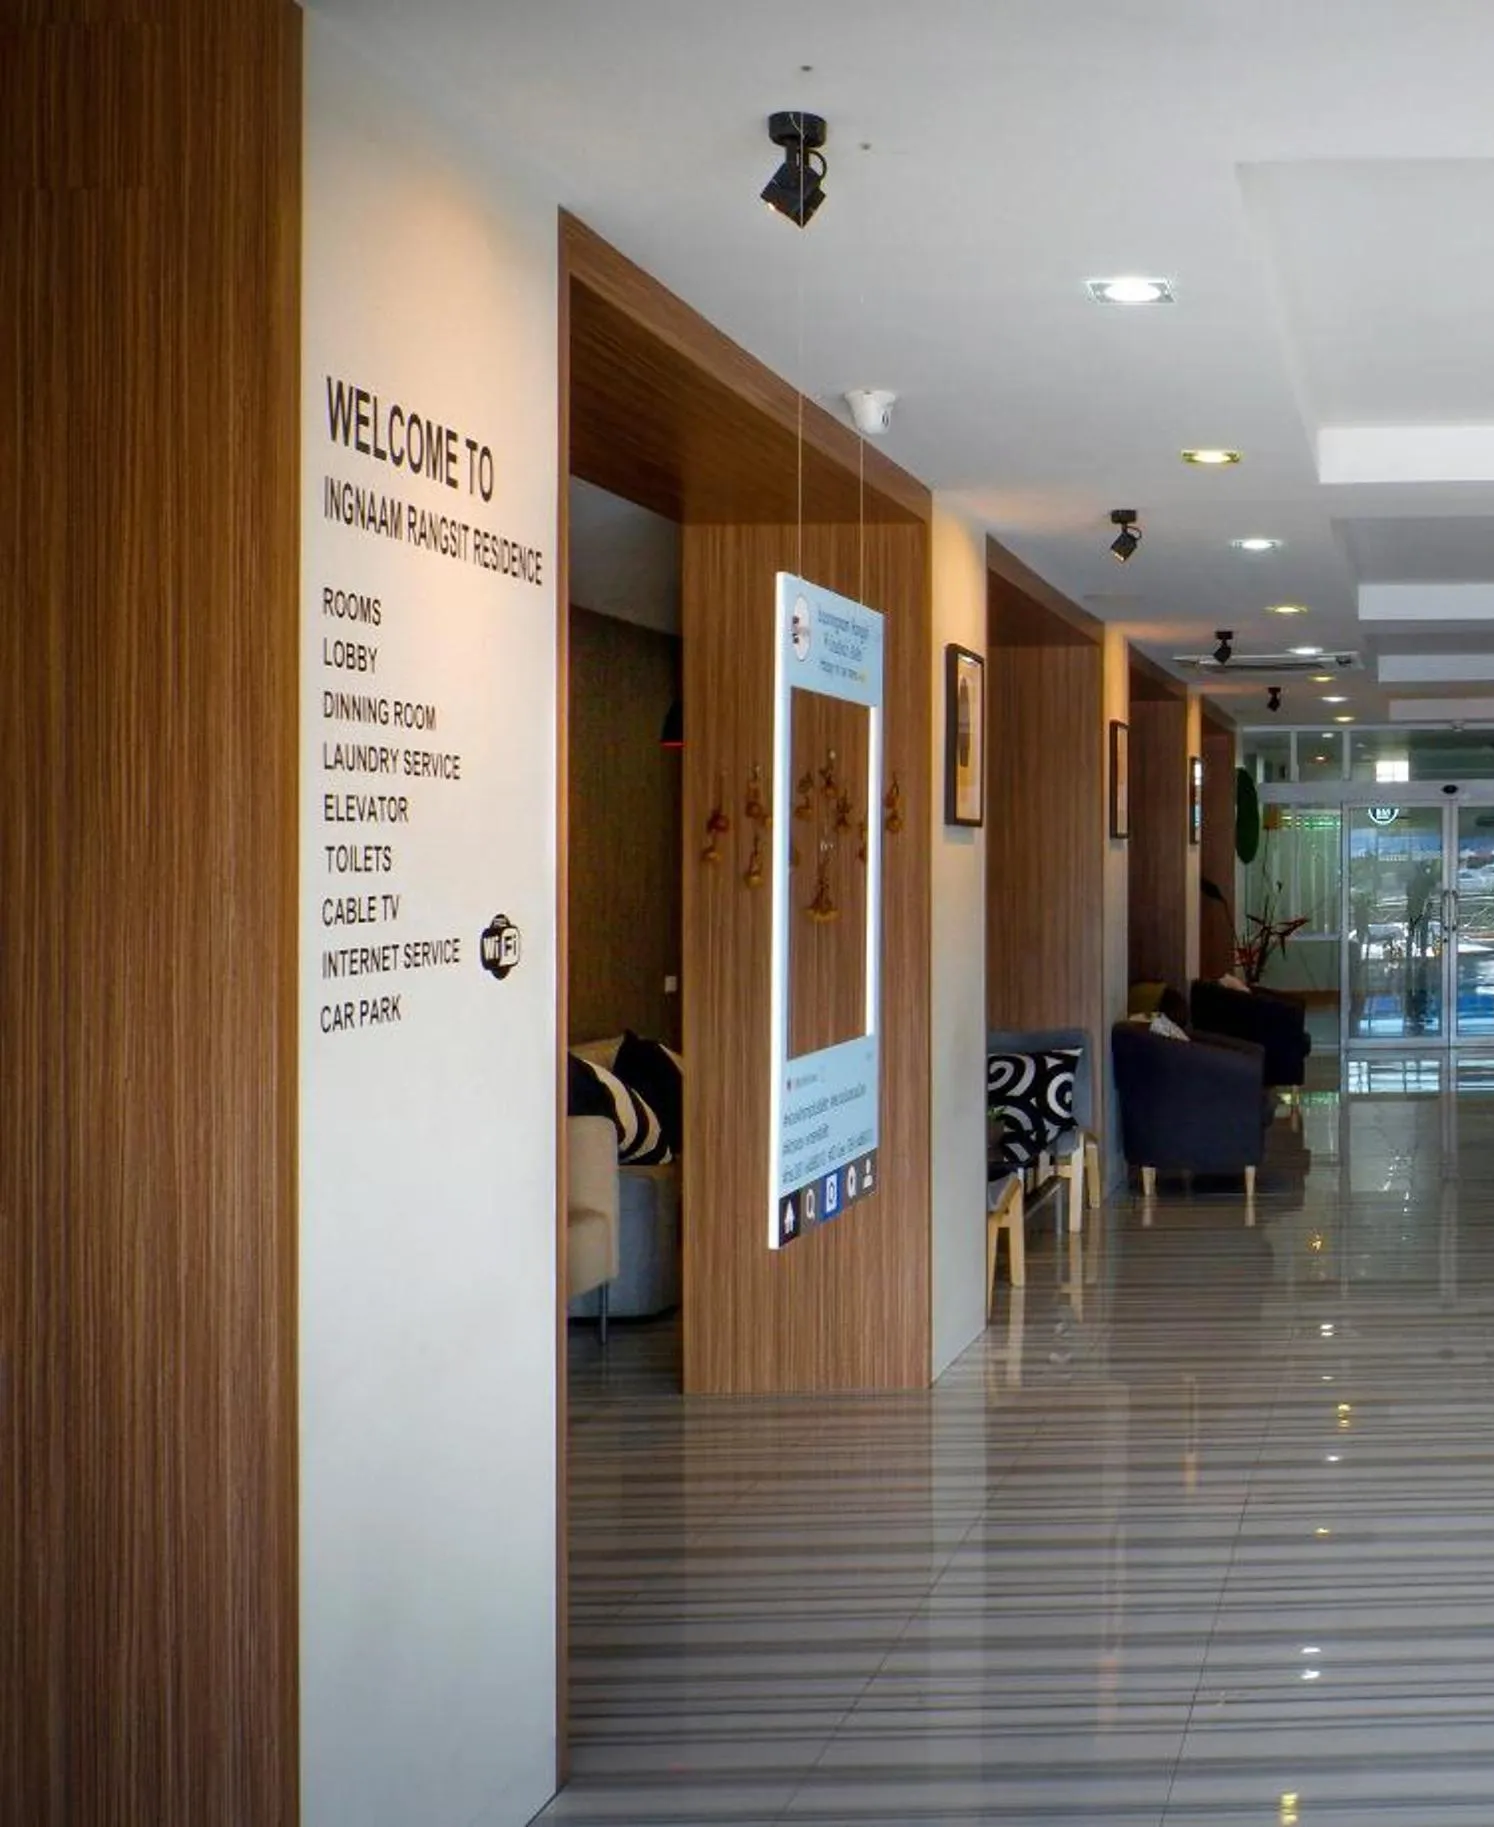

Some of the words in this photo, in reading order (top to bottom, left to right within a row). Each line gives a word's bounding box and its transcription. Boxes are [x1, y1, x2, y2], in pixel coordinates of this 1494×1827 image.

[326, 375, 459, 490] WELCOME
[465, 438, 495, 503] TO
[324, 475, 403, 541] INGNAAM
[407, 504, 469, 562] RANGSIT
[473, 528, 543, 586] RESIDENCE
[323, 586, 382, 626] ROOMS
[323, 637, 378, 674] LOBBY
[323, 690, 390, 726] DINNING
[394, 700, 437, 731] ROOM
[323, 742, 400, 774] LAUNDRY
[403, 749, 461, 781] SERVICE
[323, 794, 409, 823] ELEVATOR
[324, 845, 392, 873] TOILETS
[322, 896, 377, 926] CABLE
[382, 894, 400, 921] TV
[322, 944, 400, 979] INTERNET
[404, 938, 461, 970] SERVICE
[320, 1001, 356, 1033] CAR
[360, 994, 402, 1028] PARK
